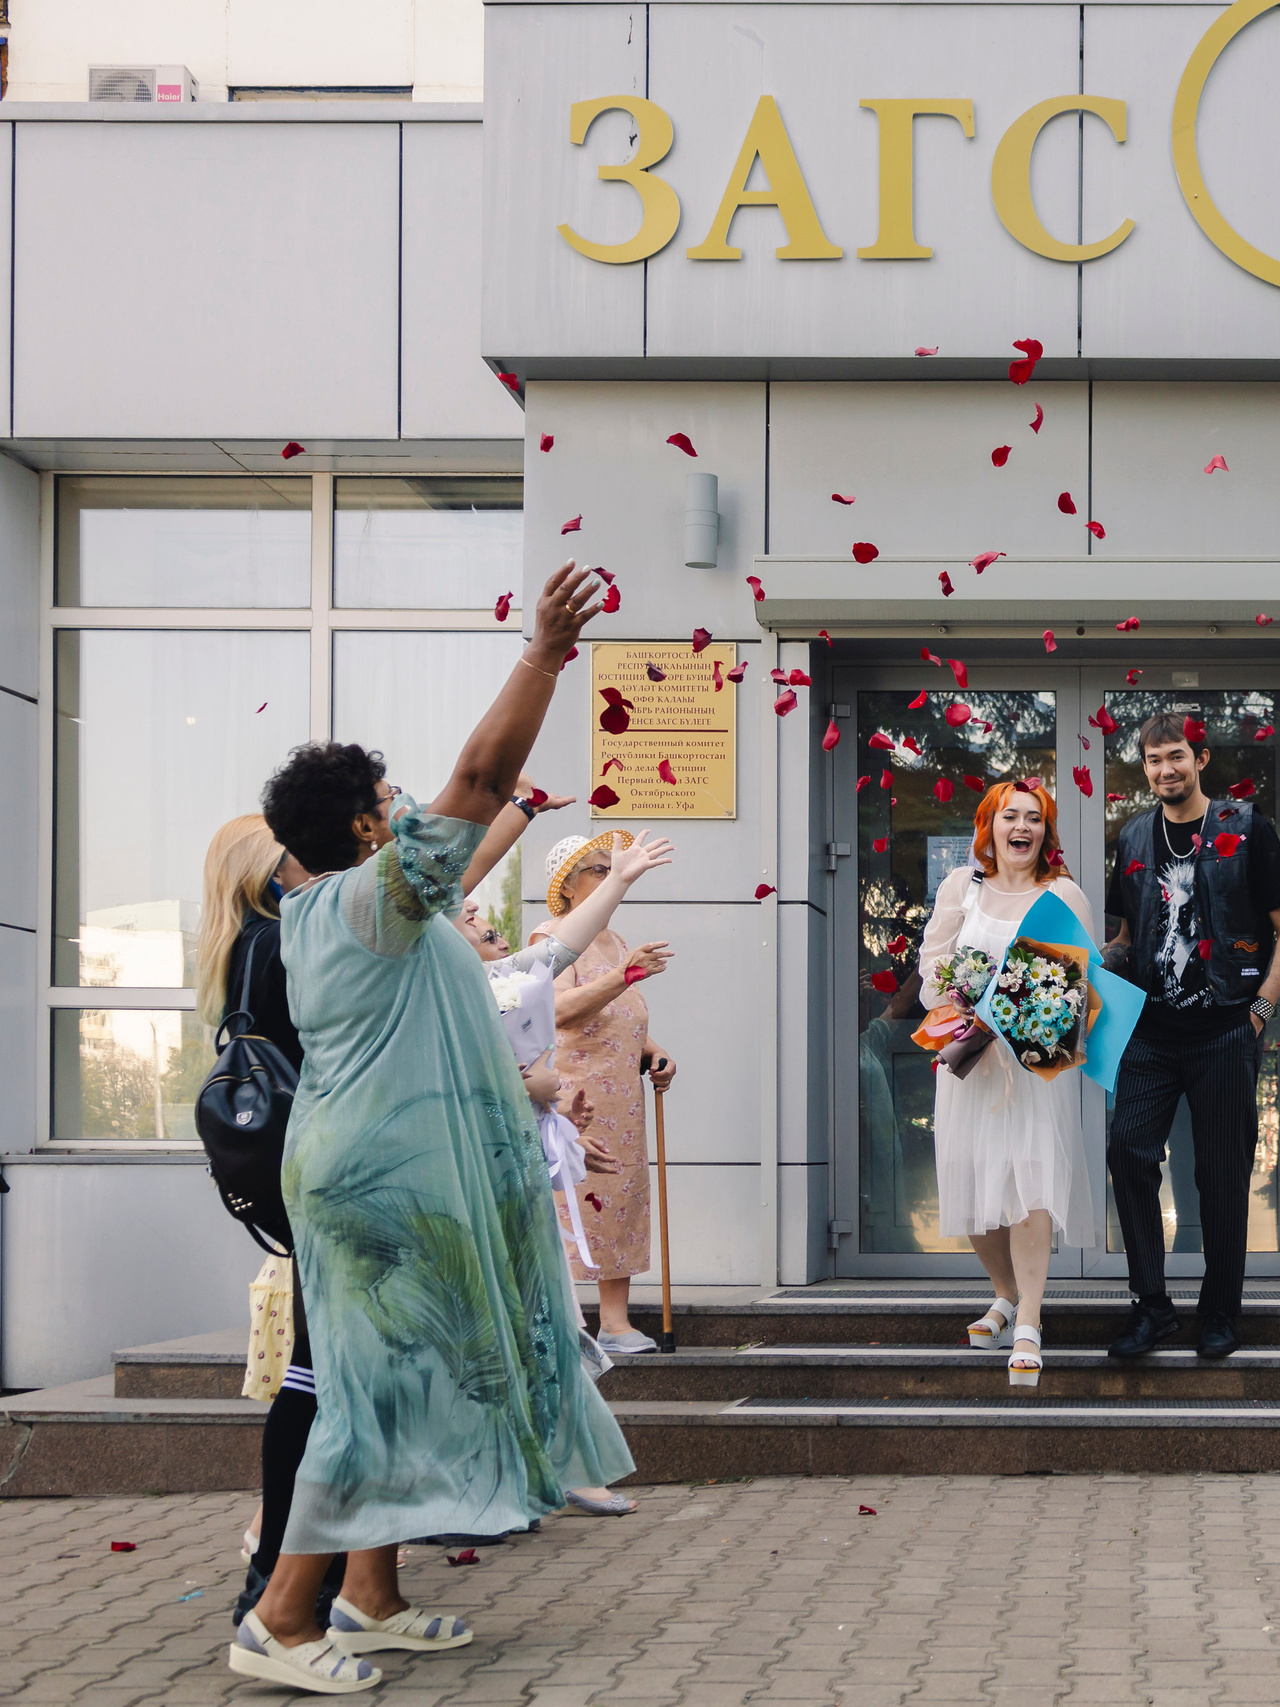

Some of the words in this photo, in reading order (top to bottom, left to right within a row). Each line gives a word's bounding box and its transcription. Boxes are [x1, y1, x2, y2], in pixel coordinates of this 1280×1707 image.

[158, 93, 180, 101] Haier
[556, 94, 1136, 265] ЗАГС
[598, 673, 645, 682] ЮСТИЦИЯ
[657, 684, 710, 693] КОМИТЕТЫ
[632, 695, 654, 703] ӨФӨ
[654, 706, 716, 716] РАЙОНЫНЫҢ
[656, 717, 678, 726] ЗАГС
[602, 738, 684, 749] Государственный
[686, 740, 726, 748] комитет
[601, 751, 656, 761] Республики
[658, 751, 726, 761] Башкортостан
[665, 765, 706, 773] стиции
[617, 775, 654, 785] Первый
[684, 776, 710, 785] ЗАГС
[630, 788, 696, 798] Октябрьского
[631, 801, 665, 811] района
[676, 801, 695, 811] Уфа
